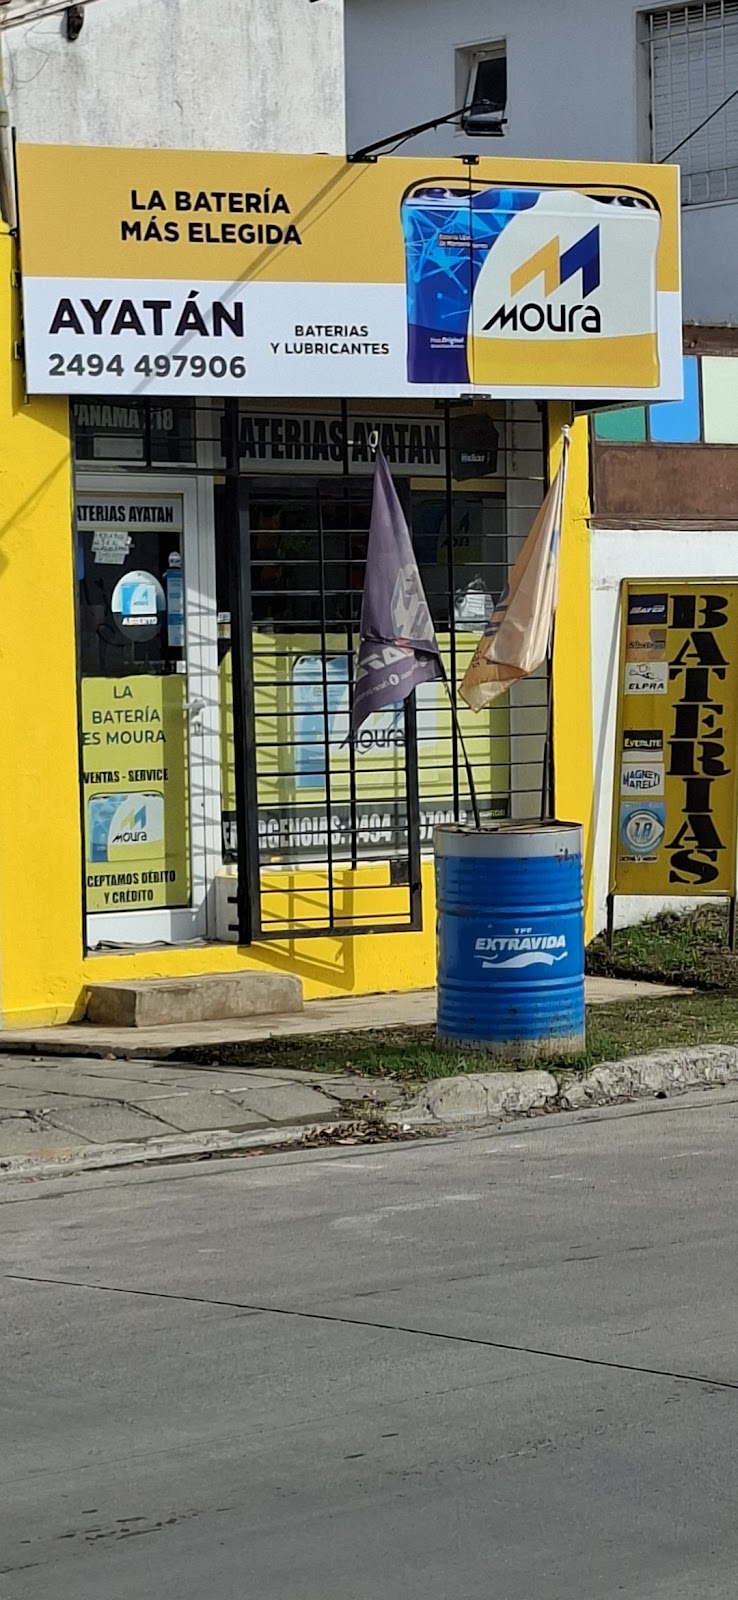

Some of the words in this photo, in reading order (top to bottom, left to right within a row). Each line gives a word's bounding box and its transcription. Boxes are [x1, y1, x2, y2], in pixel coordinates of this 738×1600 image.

[130, 190, 167, 210] LA
[175, 188, 290, 214] BATERÍA
[121, 216, 180, 242] MÁS
[188, 223, 303, 245] ELEGIDA
[49, 290, 245, 337] AYATÁN
[294, 325, 369, 337] BATERIAS
[270, 342, 279, 354] Y
[285, 342, 389, 355] LUBRICANTES
[48, 354, 125, 377] 2494
[134, 354, 246, 378] 497906
[352, 423, 441, 464] AYATAN
[128, 506, 174, 523] AYATAN
[113, 685, 133, 699] LA
[628, 682, 665, 690] ELPRA
[92, 705, 161, 724] BATERÍA
[82, 731, 101, 746] ES
[106, 730, 166, 745] MOURA
[664, 594, 732, 885] BATERIAS
[83, 771, 120, 784] VENTAS
[128, 769, 169, 782] SERVICE
[222, 814, 346, 850] ERGENCIAS:
[141, 869, 176, 884] DÉBITO
[104, 891, 110, 904] Y
[112, 888, 154, 903] CRÉDITO
[474, 935, 566, 951] EXTRAVIDA
